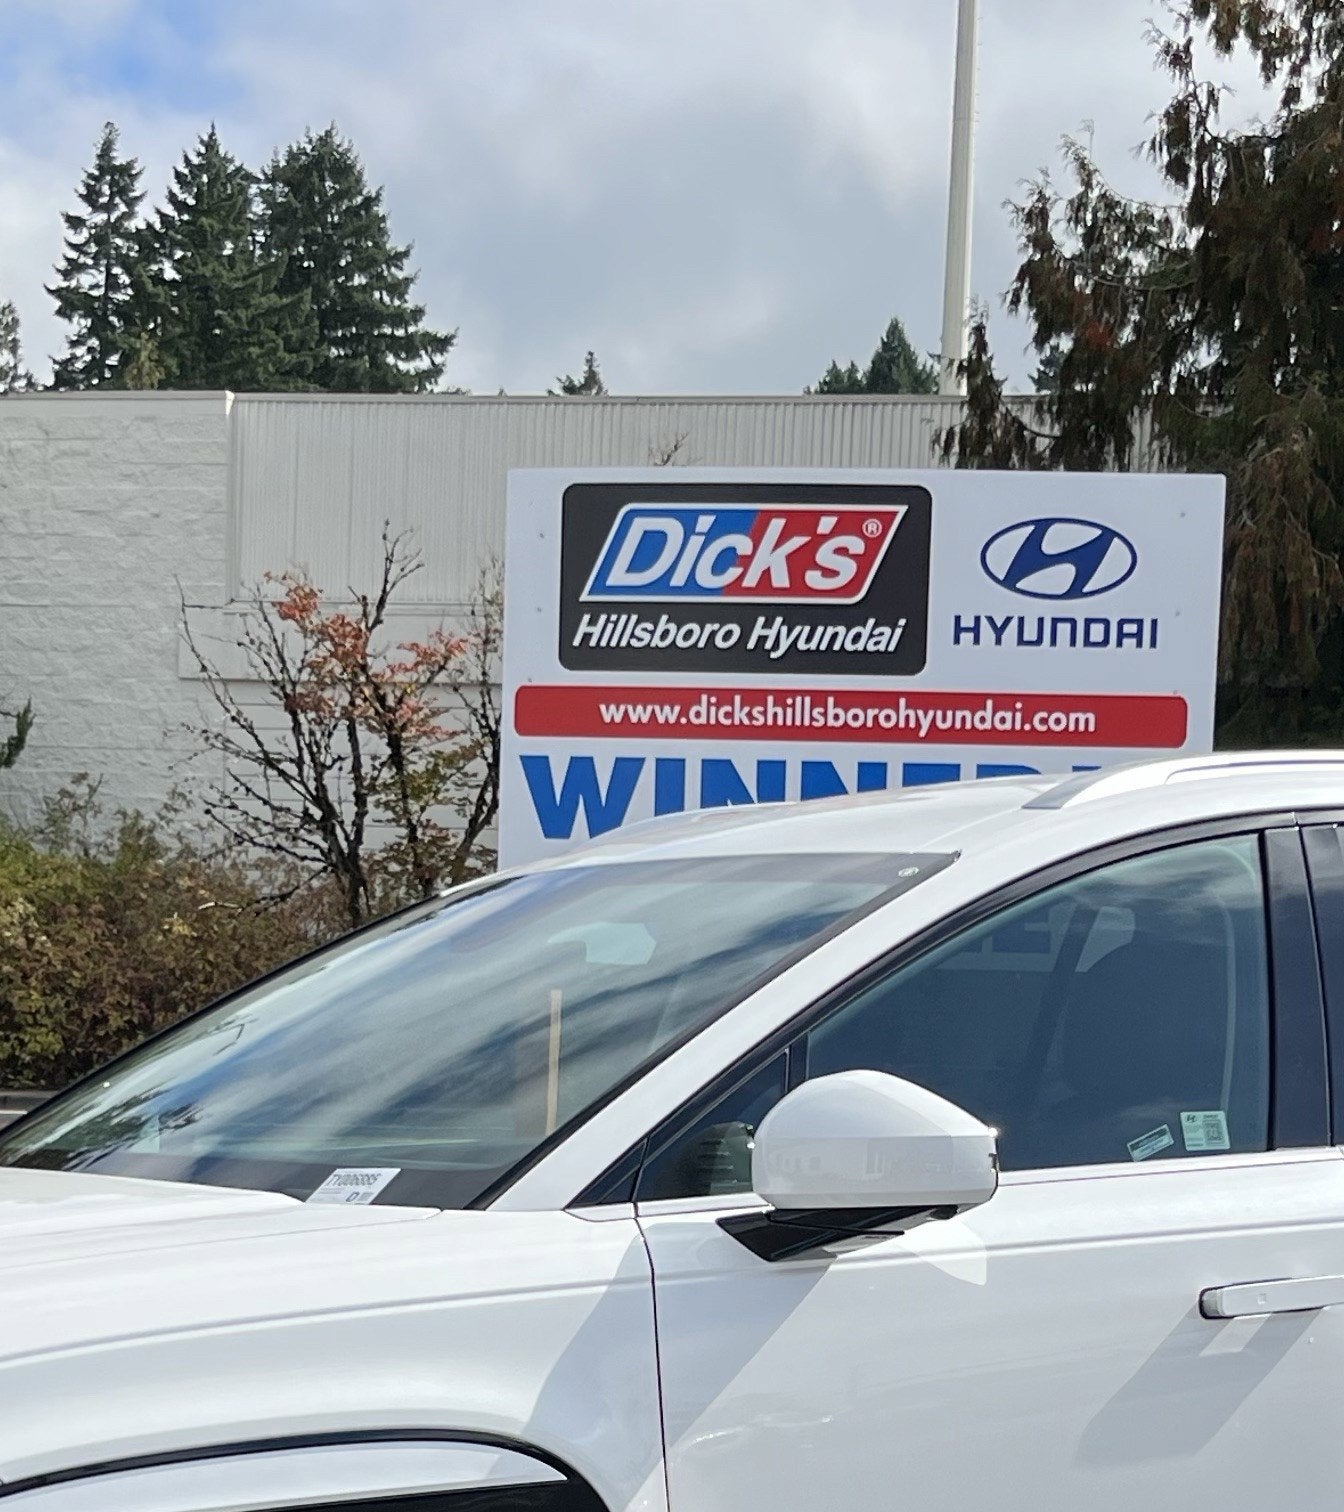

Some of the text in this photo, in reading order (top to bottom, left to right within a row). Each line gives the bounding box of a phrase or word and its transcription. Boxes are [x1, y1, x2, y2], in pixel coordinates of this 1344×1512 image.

[607, 512, 863, 588] Dick's
[572, 613, 907, 660] Hillsboro Hyundai
[953, 615, 1159, 649] HYUNDAI
[599, 694, 1097, 734] www.dickshillsborohyundai.com
